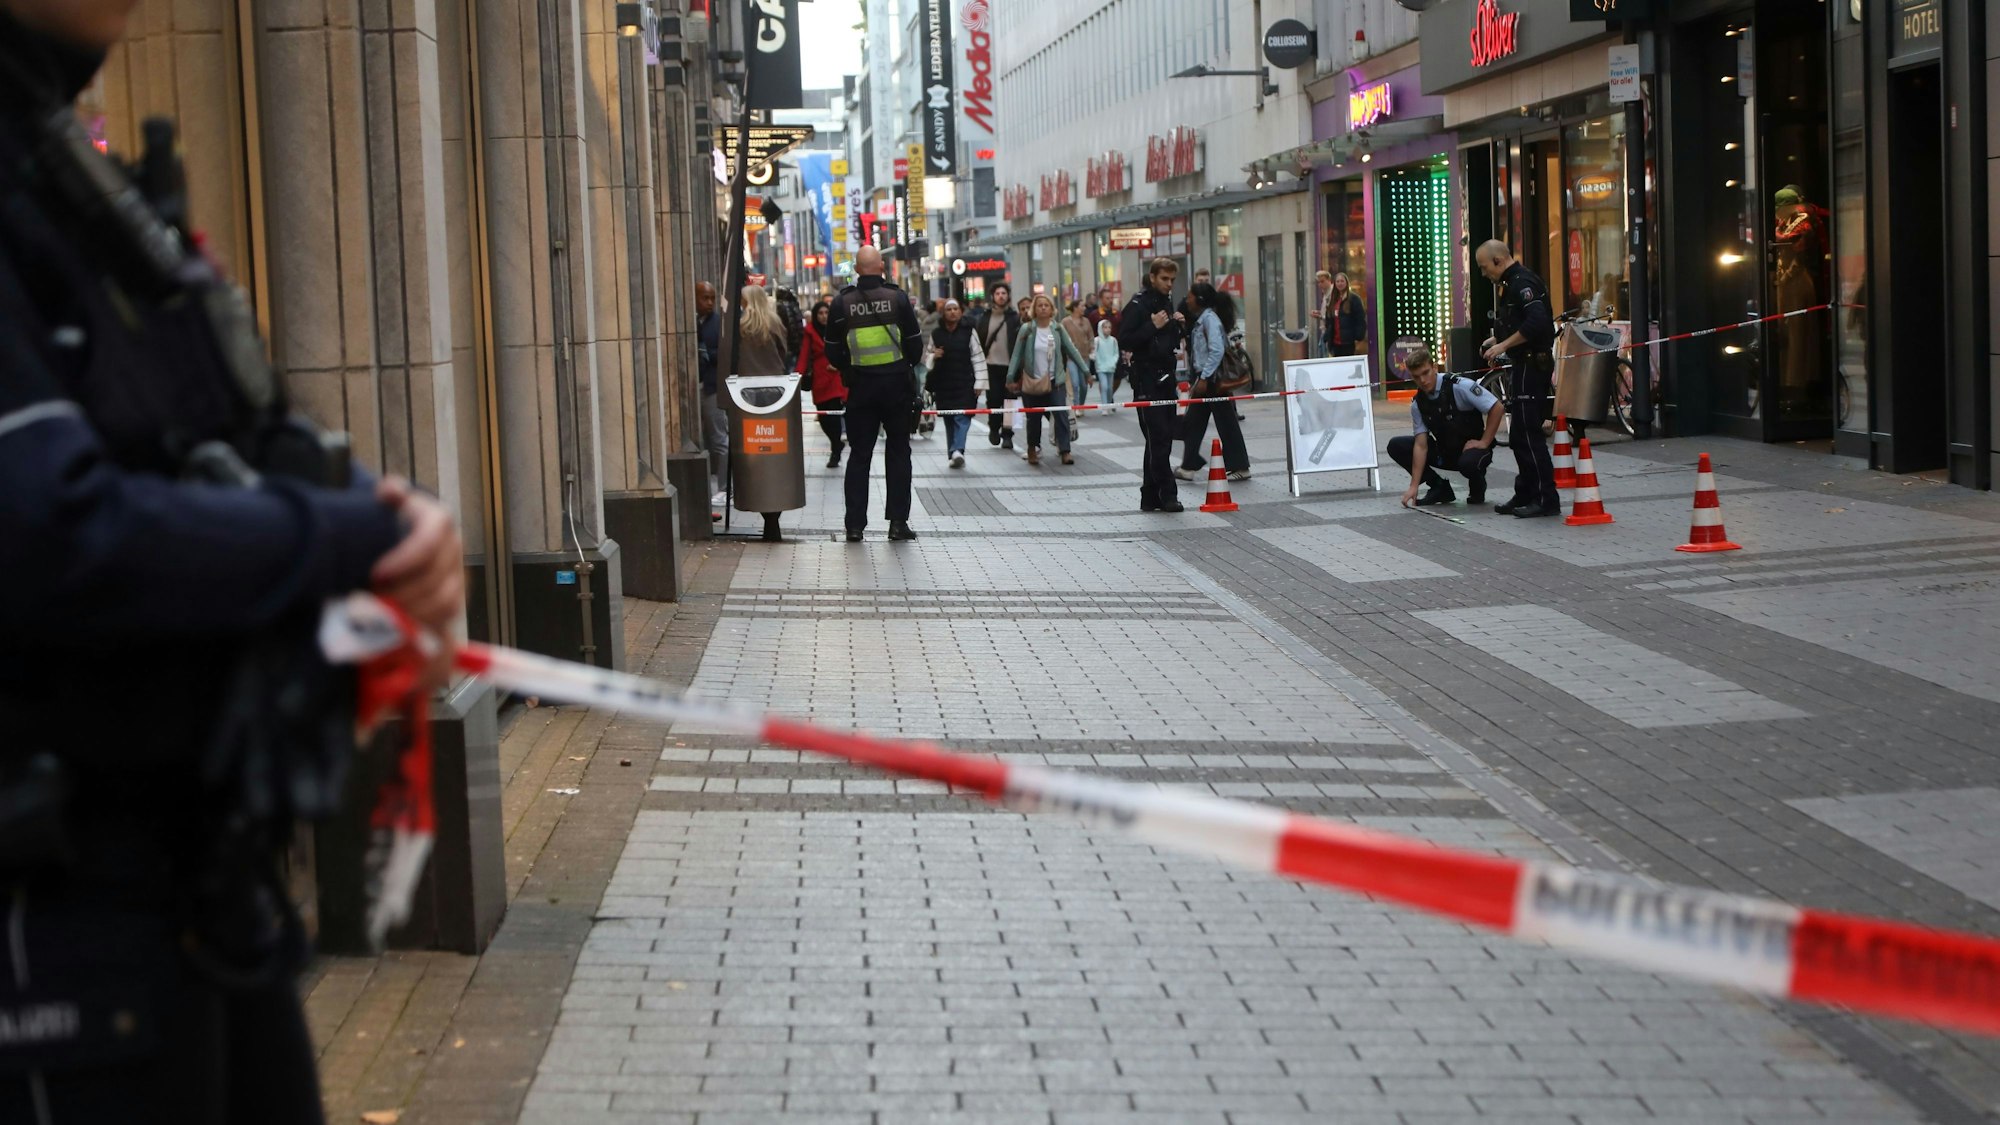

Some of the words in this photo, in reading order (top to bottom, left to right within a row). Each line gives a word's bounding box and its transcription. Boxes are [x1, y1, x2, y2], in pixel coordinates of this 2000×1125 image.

[1903, 9, 1939, 39] HOTEL
[1268, 36, 1307, 47] COLLOSEUM
[933, 109, 947, 152] SANDY
[909, 155, 924, 225] CHURROS
[850, 300, 892, 316] POLIZEI
[755, 425, 775, 435] Afval
